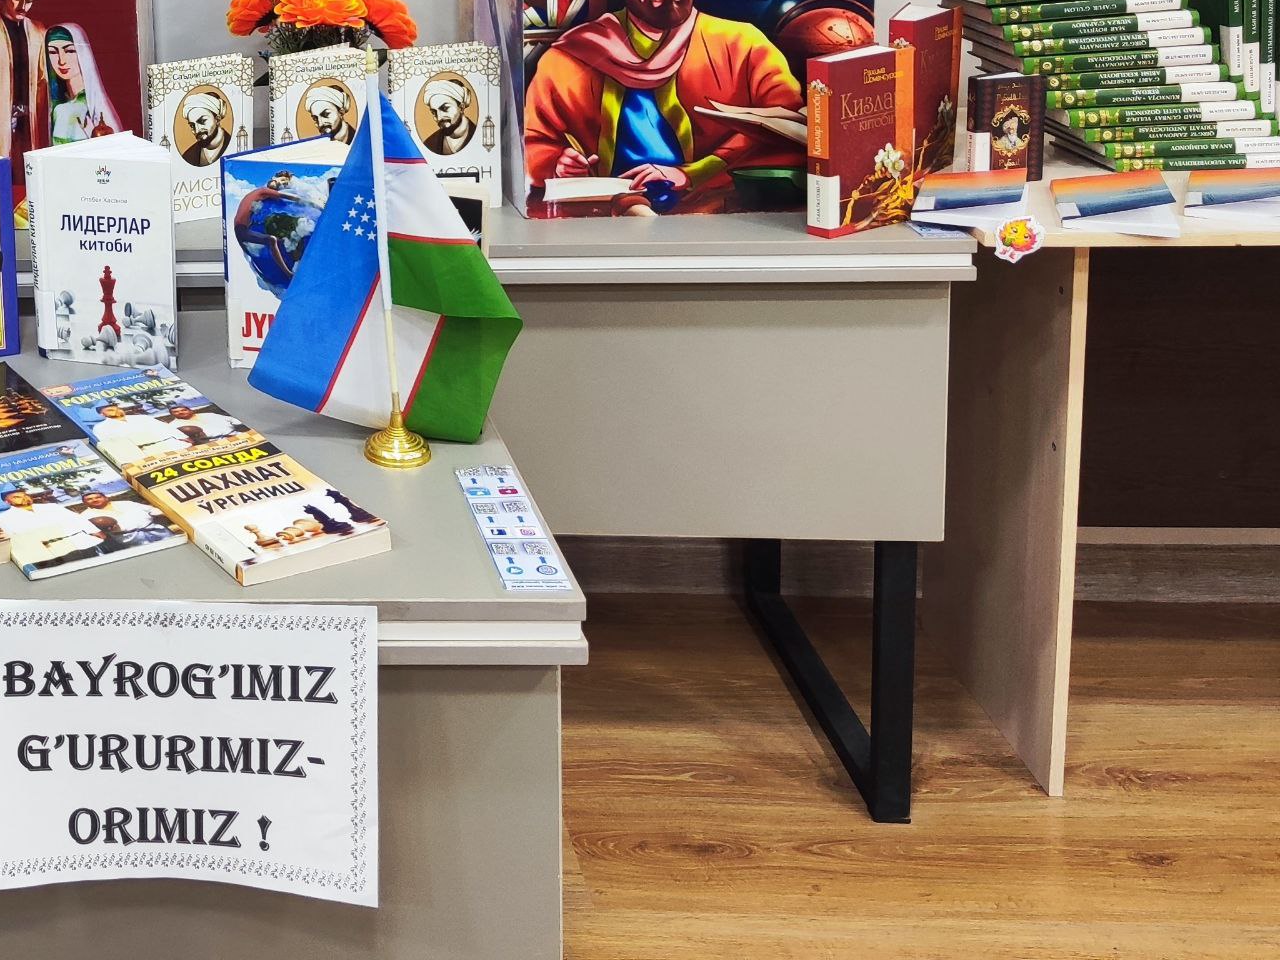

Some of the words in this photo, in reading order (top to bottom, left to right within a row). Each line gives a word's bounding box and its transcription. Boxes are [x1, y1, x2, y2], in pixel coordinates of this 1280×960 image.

[60, 214, 151, 236] ЛИДЕРЛАР
[79, 238, 133, 253] китоби
[150, 467, 179, 483] 24
[181, 448, 269, 473] СОАТДА
[166, 461, 292, 503] ШАХМАТ
[197, 480, 306, 514] ЎРГАНИШ
[2, 652, 339, 705] BAYROG’IMIZ
[17, 733, 326, 779] G’URURIMIZ-
[68, 807, 242, 848] ORIMIZ
